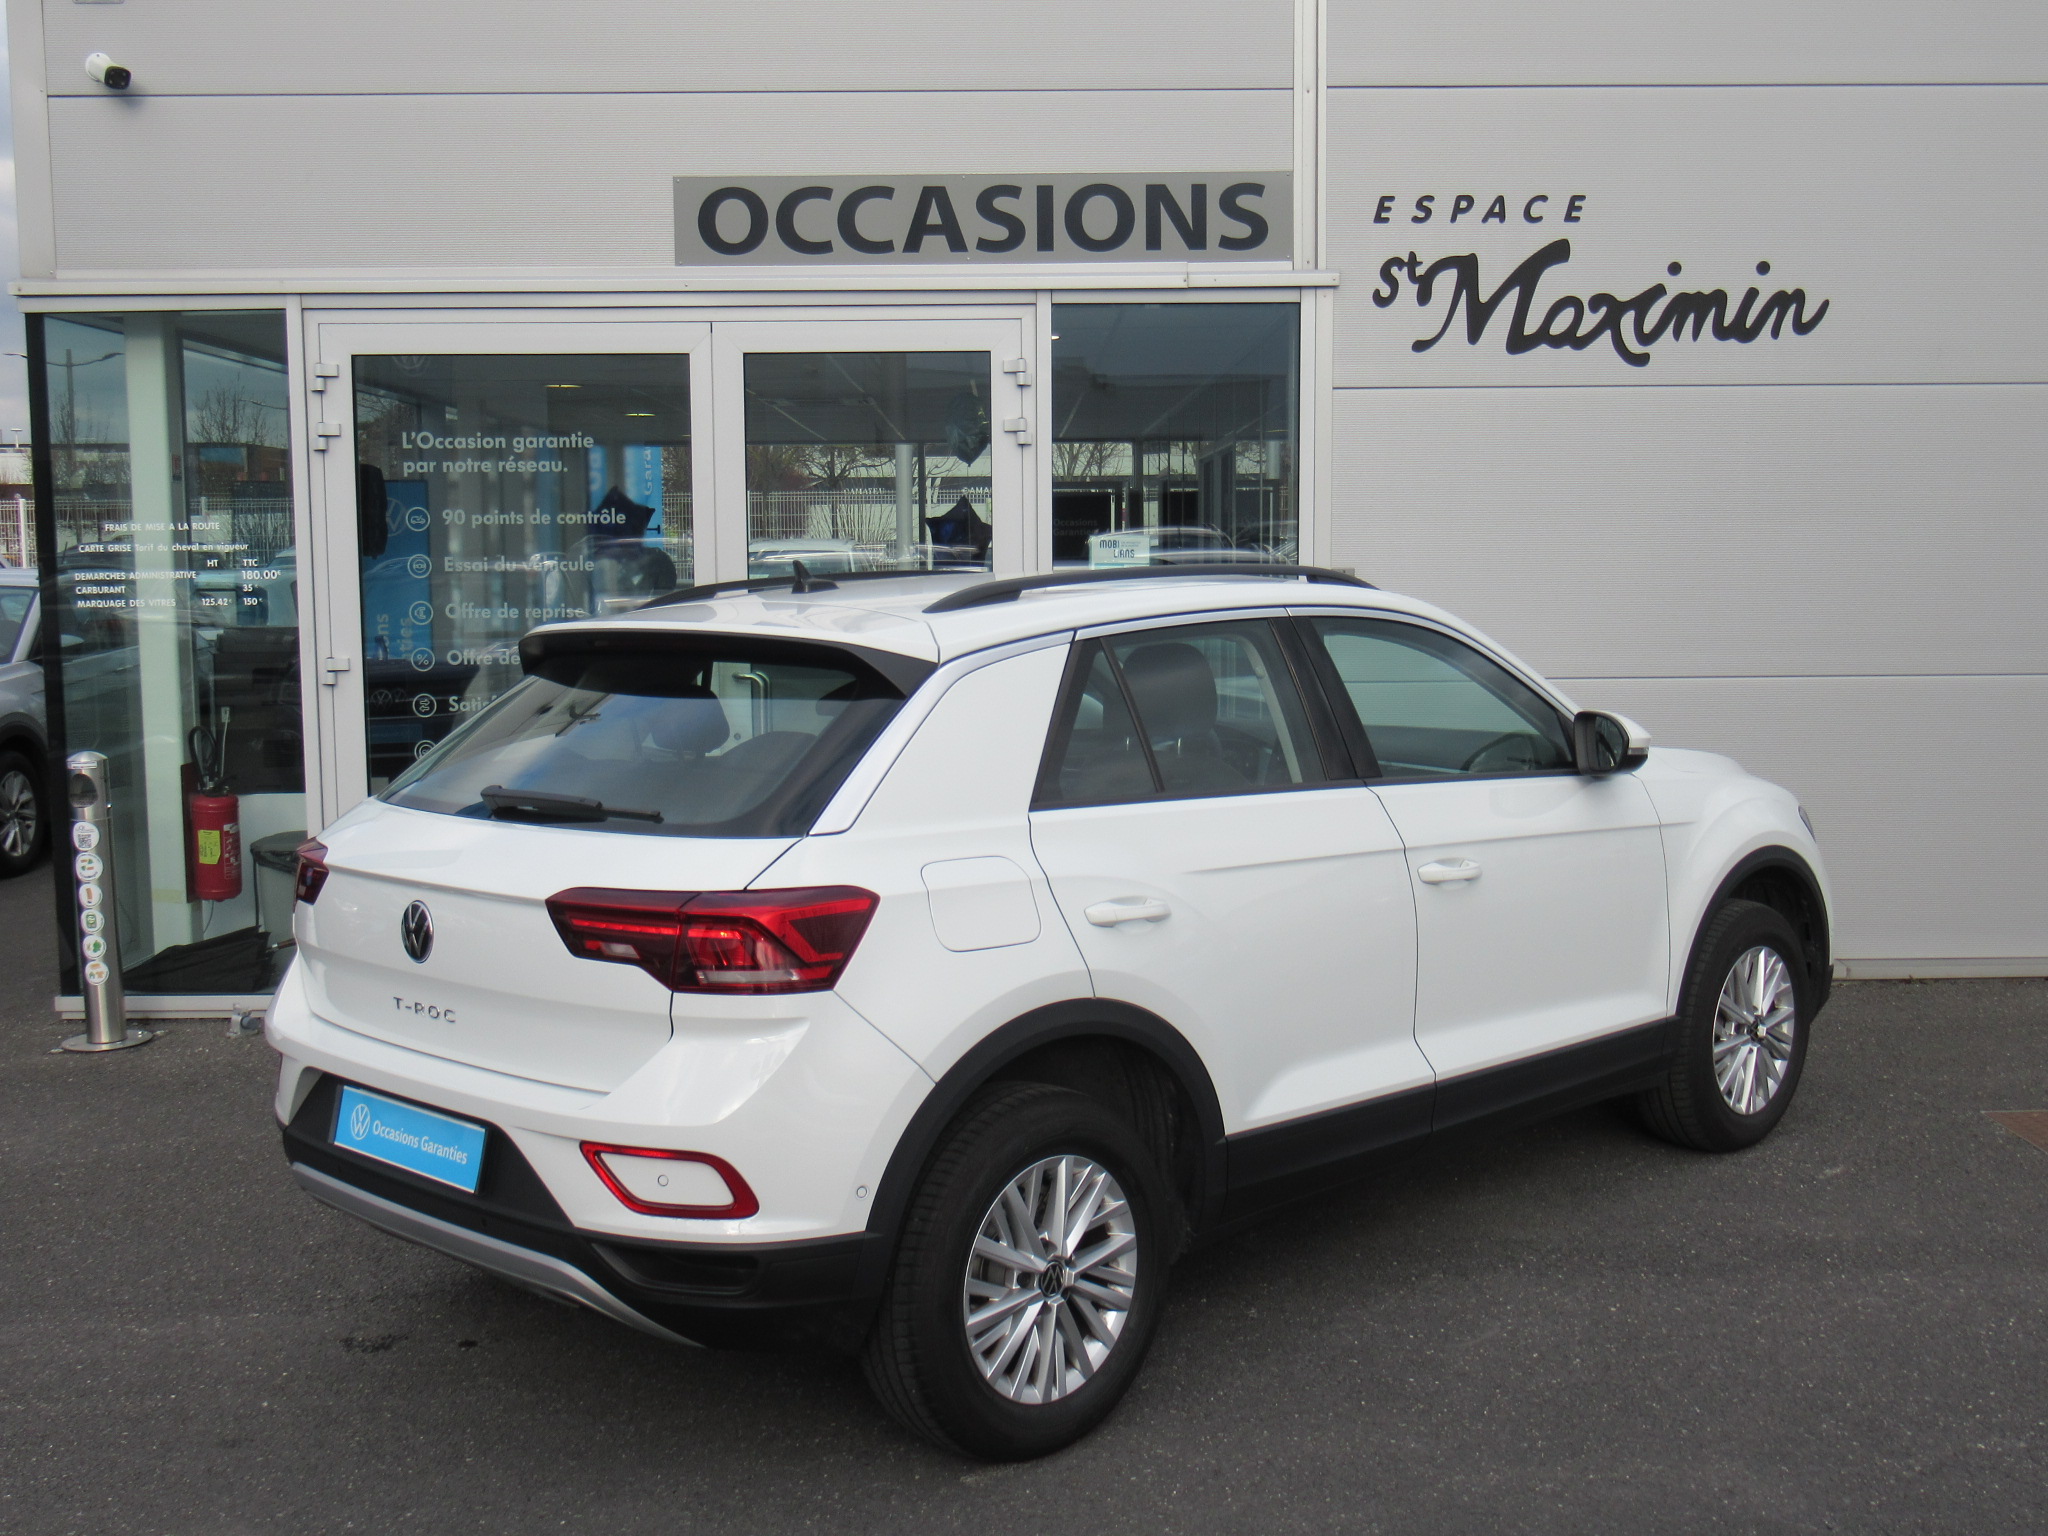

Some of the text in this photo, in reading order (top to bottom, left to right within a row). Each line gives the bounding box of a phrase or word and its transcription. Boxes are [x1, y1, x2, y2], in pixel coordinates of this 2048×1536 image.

[697, 182, 1270, 255] OCCASIONS
[1373, 195, 1587, 224] ESPACE
[1411, 238, 1830, 368] Maximin
[401, 431, 595, 453] L'Occasion garantie
[403, 456, 568, 477] par notre réseau.
[104, 523, 128, 532] FRAIS
[130, 523, 142, 531] DE
[145, 522, 165, 531] MISE
[178, 522, 190, 531] LA
[192, 522, 220, 530] ROUTE
[442, 507, 627, 529] 90 points de contrôle
[78, 542, 249, 553] CARTE GRISE Tarif du cheval en vigueur
[207, 559, 218, 567] HT
[242, 559, 258, 567] TTC
[444, 555, 595, 573] Essai du véhicule
[74, 570, 197, 580] DEMARCHES ADMINISTRATIVE
[75, 585, 126, 595] CARBURANT
[77, 598, 176, 608] MARQUAGE DES VITRES
[445, 602, 586, 624] Offre de reprise
[446, 649, 521, 666] Offre de
[393, 996, 456, 1023] T-ROC
[372, 1119, 468, 1165] Occasions Garanties
